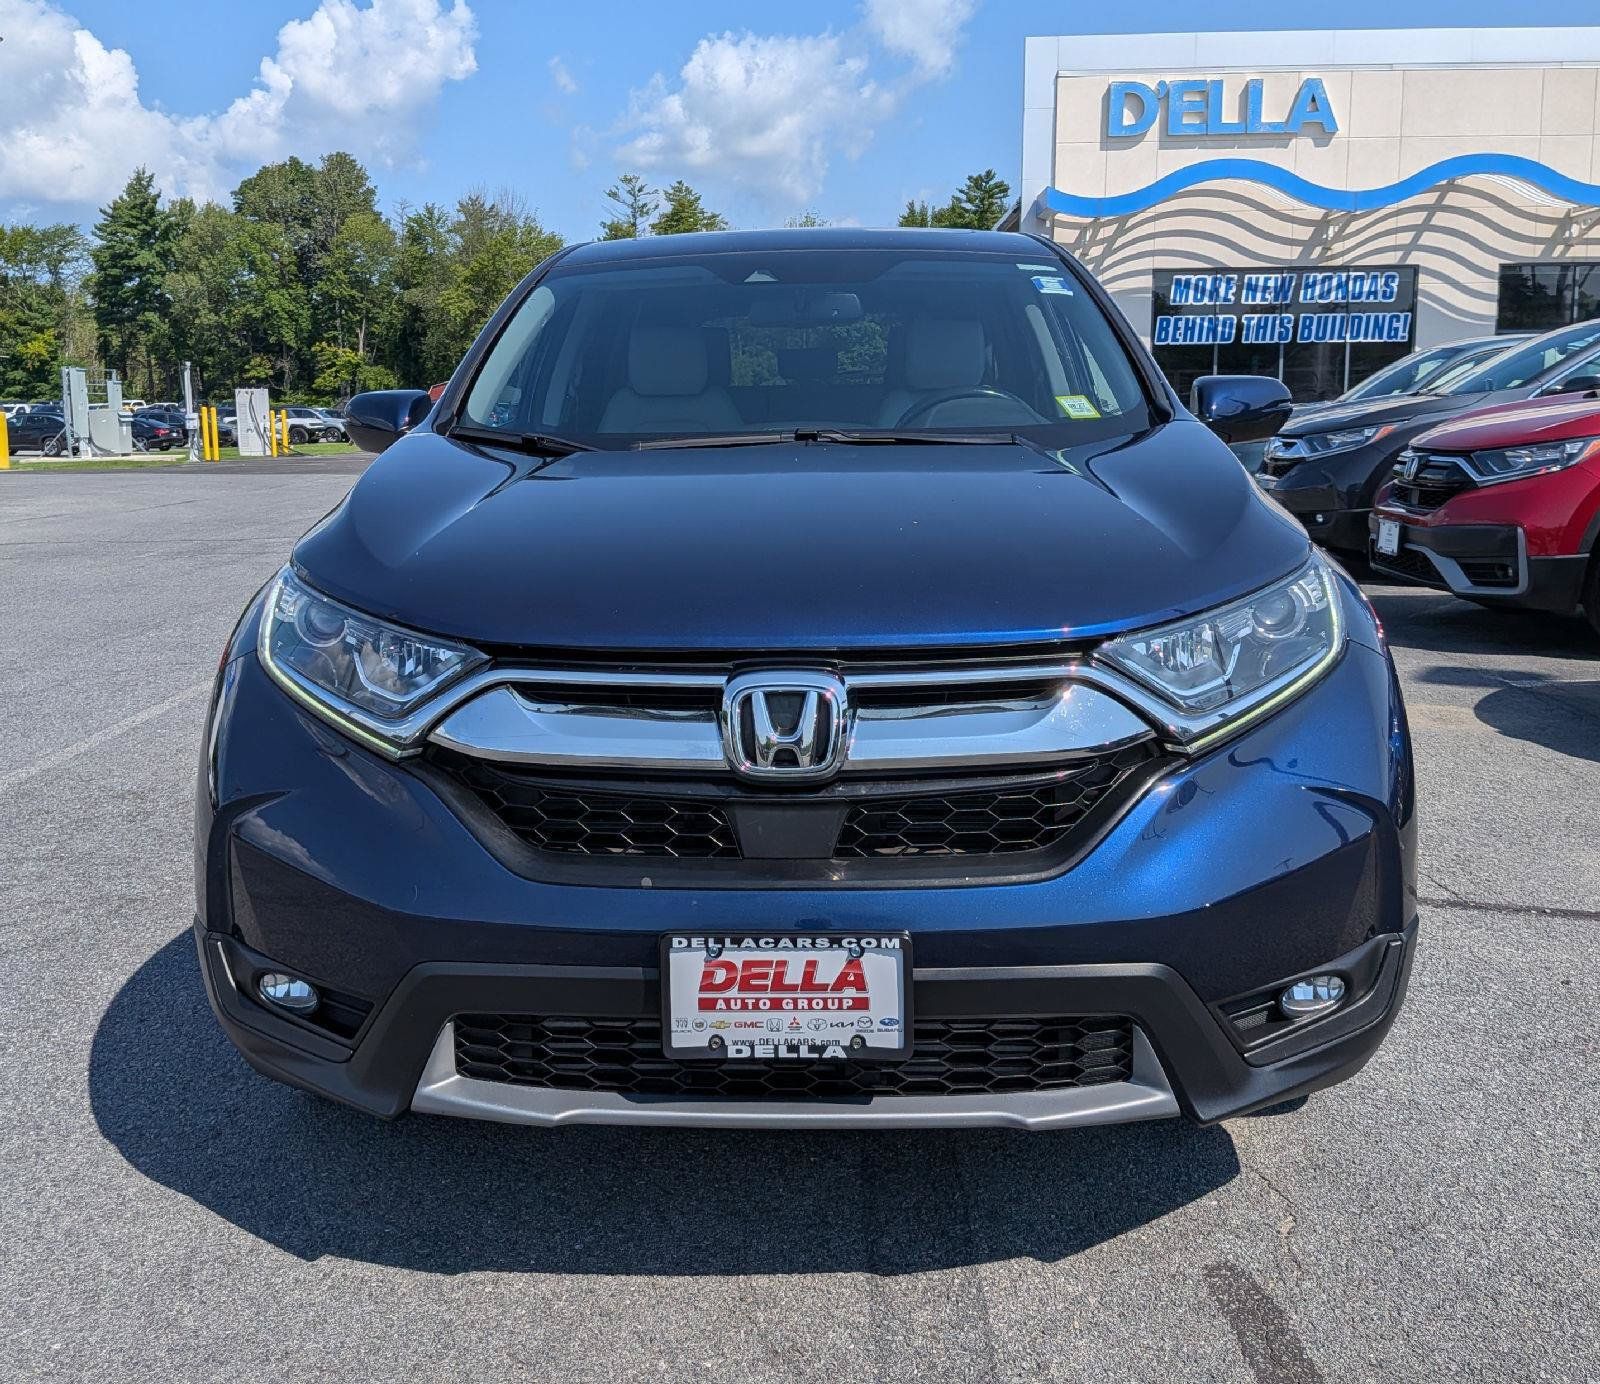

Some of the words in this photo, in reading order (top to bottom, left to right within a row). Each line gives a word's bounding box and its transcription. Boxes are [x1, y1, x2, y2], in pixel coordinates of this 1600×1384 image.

[1170, 274, 1237, 305] MORE
[1241, 273, 1297, 304] NEW
[1299, 272, 1399, 303] HONDAS
[1154, 315, 1236, 345] BEHIND
[1241, 314, 1293, 344] THIS
[1298, 312, 1411, 342] BUILDING!
[672, 937, 900, 949] DELLACARS.COM
[698, 959, 869, 993] DELLA
[715, 999, 771, 1010] AUTO
[782, 999, 854, 1010] GROUP
[734, 1021, 764, 1029] GMC
[727, 1045, 848, 1058] DELLA
